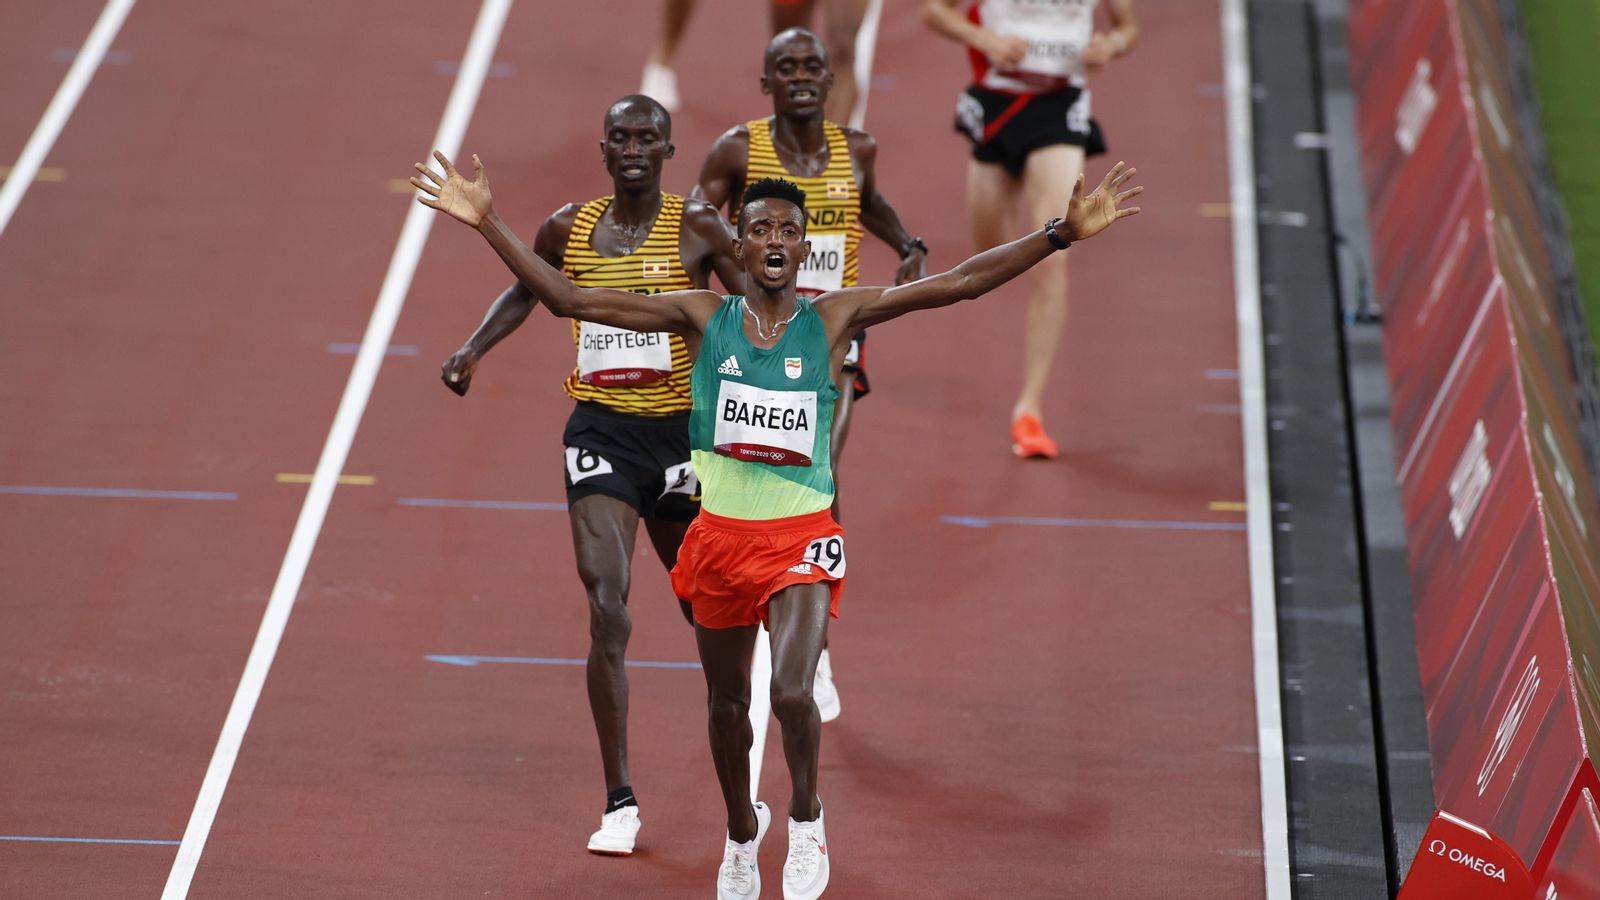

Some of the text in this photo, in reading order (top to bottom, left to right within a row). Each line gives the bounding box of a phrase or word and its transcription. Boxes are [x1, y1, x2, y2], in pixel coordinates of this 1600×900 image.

[808, 210, 846, 225] NDA
[799, 251, 839, 271] IMO
[583, 332, 661, 350] CHEPTEGEI
[717, 367, 743, 376] adidas
[723, 398, 808, 431] BAREGA
[740, 448, 756, 456] TOKYO
[811, 538, 842, 572] 19
[1448, 848, 1506, 882] OMEGA
